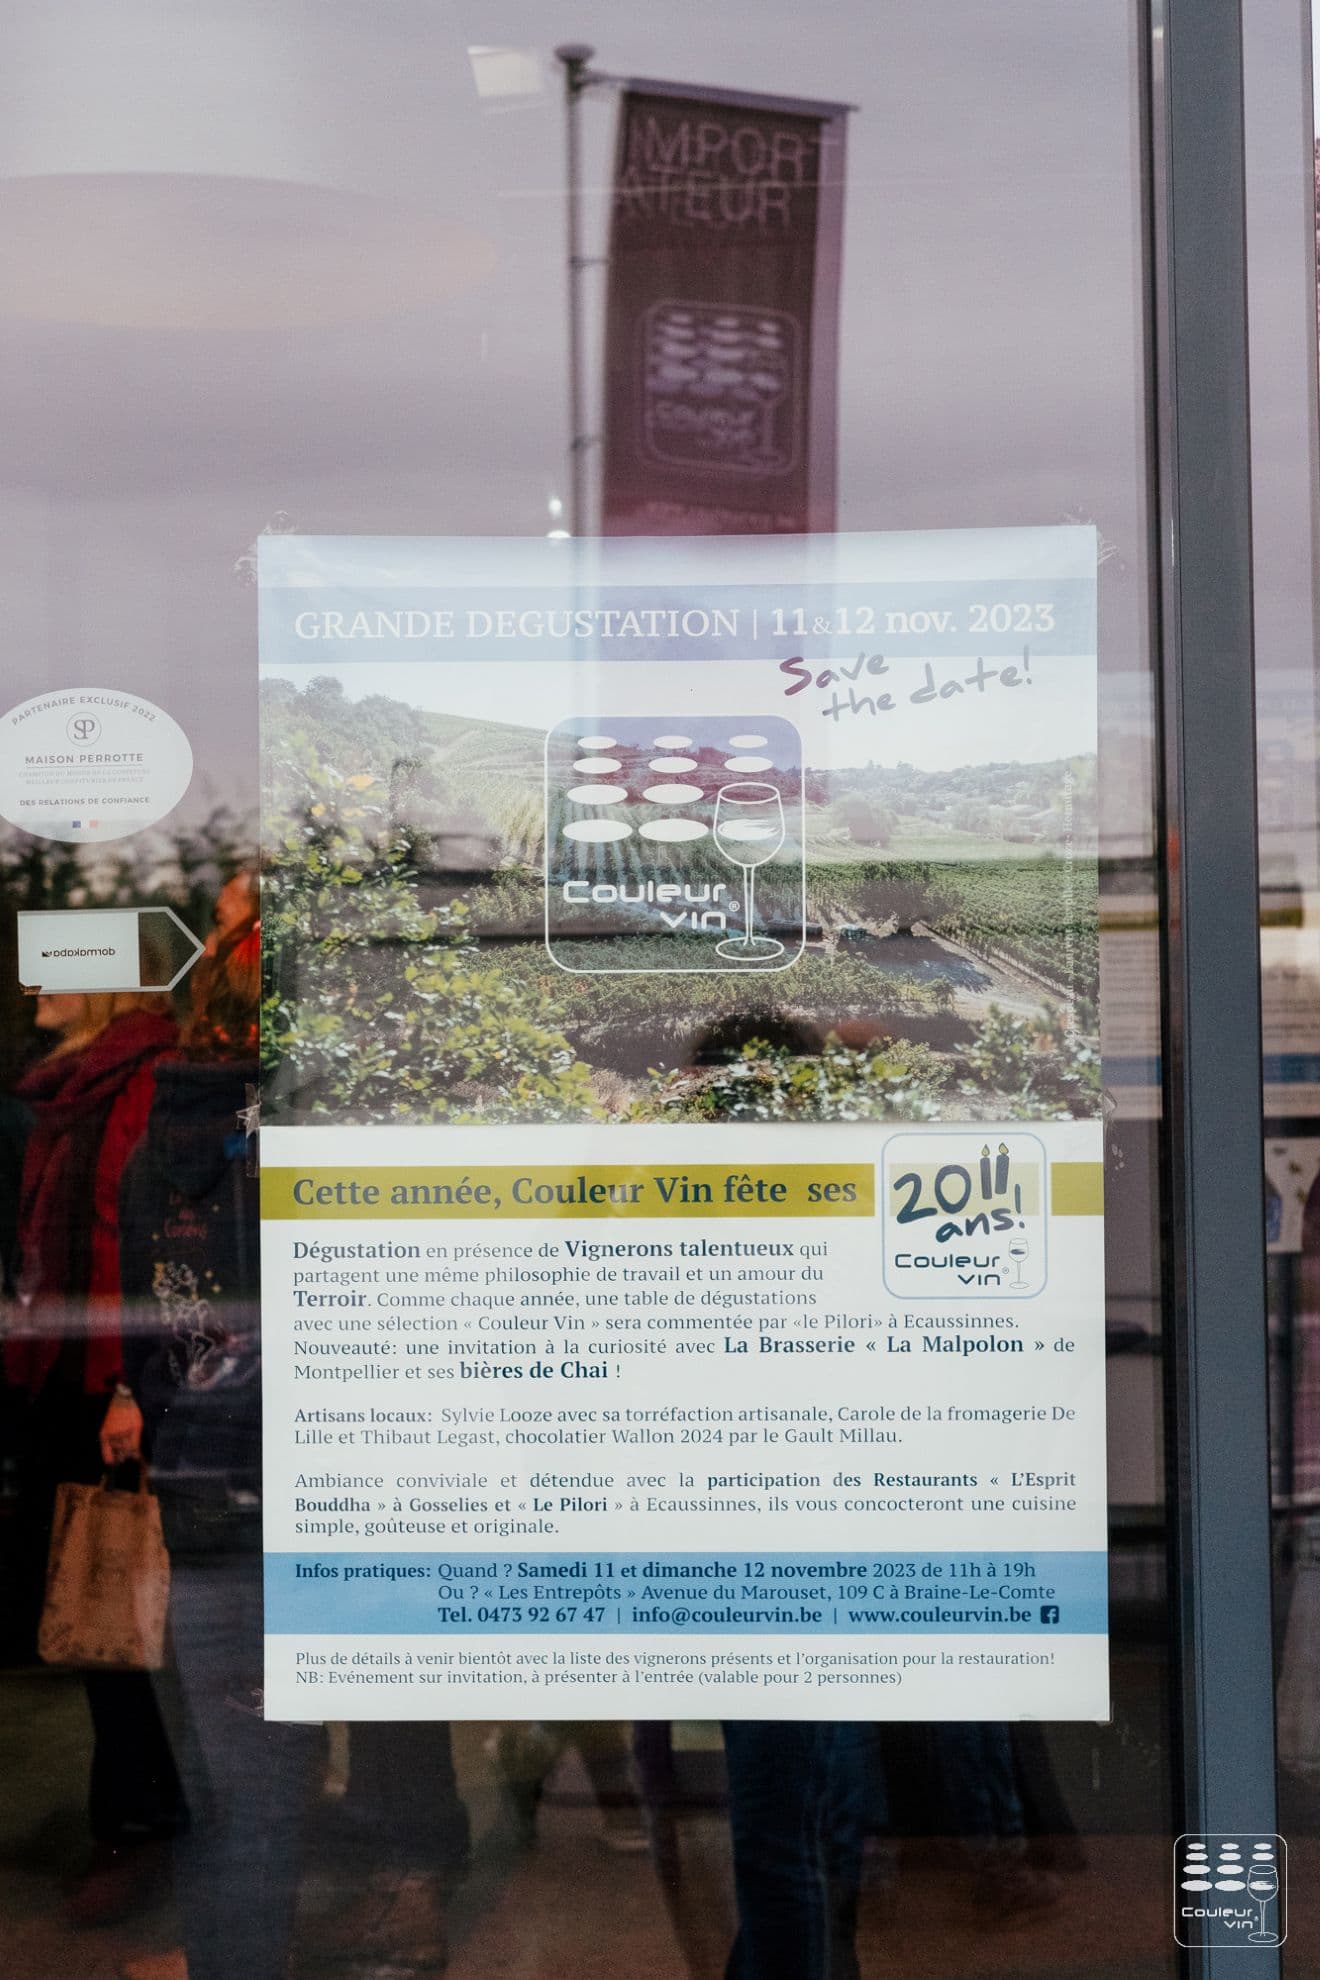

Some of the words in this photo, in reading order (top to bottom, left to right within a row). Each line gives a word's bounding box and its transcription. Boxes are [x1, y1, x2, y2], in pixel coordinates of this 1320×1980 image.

[295, 611, 454, 638] GRANDE
[466, 609, 741, 638] DEGUSTATION
[886, 609, 957, 633] nov.
[969, 603, 1056, 633] 2023
[779, 652, 890, 697] Save
[821, 687, 897, 722] the
[909, 645, 1033, 705] date!
[11, 695, 76, 726] PARTENAIRE
[80, 696, 129, 710] EXCLUSIF
[131, 705, 157, 722] 2022
[24, 754, 75, 765] MAISON
[79, 752, 145, 763] PERROTTE
[19, 798, 37, 807] DES
[38, 798, 86, 807] RELATIONS
[88, 797, 100, 806] DE
[101, 796, 150, 805] CONFIANCE
[563, 880, 726, 904] Couleur
[293, 1178, 380, 1206] Cette
[391, 1176, 501, 1210] année,
[512, 1176, 645, 1205] Couleur
[653, 1176, 713, 1203] Vin
[723, 1174, 787, 1202] fête
[808, 1183, 856, 1202] ses
[935, 1183, 1026, 1243] ans!
[293, 1241, 421, 1262] Dégustation
[426, 1248, 447, 1258] en
[454, 1243, 532, 1261] présence
[538, 1243, 559, 1257] de
[564, 1240, 673, 1261] Vignerons
[680, 1239, 794, 1256] talentueux
[800, 1242, 827, 1259] qui
[895, 1253, 1000, 1268] Couleur
[293, 1290, 371, 1307] Terroir.
[377, 1293, 445, 1307] Comme
[451, 1292, 515, 1310] chaque
[520, 1292, 579, 1309] année,
[586, 1295, 618, 1305] une
[624, 1291, 668, 1305] table
[674, 1291, 695, 1305] de
[701, 1290, 816, 1308] dégustations
[294, 1365, 399, 1382] Montpellier
[405, 1366, 421, 1379] et
[428, 1368, 454, 1379] ses
[460, 1361, 523, 1378] bières
[529, 1361, 553, 1378] de
[561, 1361, 608, 1378] Chai
[295, 1408, 365, 1423] Artisans
[370, 1408, 431, 1422] locaux:
[442, 1408, 494, 1425] Sylvie
[500, 1408, 552, 1422] Looze
[557, 1411, 597, 1422] avec
[603, 1411, 620, 1422] sa
[626, 1406, 733, 1422] torréfaction
[738, 1406, 832, 1423] artisanale,
[838, 1406, 895, 1421] Carole
[900, 1406, 921, 1421] de
[927, 1406, 942, 1421] la
[948, 1406, 1046, 1424] fromagerie
[1052, 1406, 1075, 1420] De
[295, 1429, 333, 1447] Lille
[339, 1432, 355, 1445] et
[361, 1429, 431, 1444] Thibaut
[437, 1430, 500, 1447] Legast,
[506, 1429, 606, 1446] chocolatier
[611, 1429, 674, 1443] Wallon
[681, 1429, 723, 1443] 2024
[728, 1432, 758, 1446] par
[764, 1428, 779, 1443] le
[785, 1428, 833, 1443] Gault
[840, 1428, 902, 1442] Millau.
[296, 1519, 359, 1536] simple,
[365, 1517, 445, 1536] goûteuse
[451, 1521, 468, 1533] et
[474, 1518, 559, 1536] originale.
[296, 1563, 339, 1578] Infos
[344, 1563, 430, 1581] pratiques:
[438, 1563, 498, 1581] Quand
[518, 1561, 587, 1577] Samedi
[594, 1562, 615, 1577] 11
[621, 1565, 637, 1577] et
[642, 1560, 737, 1578] dimanche
[744, 1562, 765, 1577] 12
[771, 1561, 867, 1577] novembre
[873, 1561, 916, 1577] 2023
[921, 1562, 942, 1577] de
[950, 1562, 981, 1577] 11h
[986, 1561, 998, 1578] à
[1004, 1562, 1036, 1577] 19h
[438, 1585, 464, 1599] Ou
[498, 1586, 528, 1599] Les
[533, 1583, 621, 1603] Entrepôts
[641, 1585, 707, 1600] Avenue
[712, 1585, 736, 1600] du
[740, 1582, 831, 1602] Marouset,
[838, 1585, 868, 1599] 109
[872, 1584, 885, 1600] C
[888, 1584, 900, 1600] à
[904, 1585, 1055, 1599] Braine-Le-Comte
[438, 1606, 472, 1622] Tel.
[478, 1607, 522, 1622] 0473
[528, 1607, 549, 1622] 92
[556, 1607, 577, 1622] 67
[583, 1607, 605, 1622] 47
[632, 1606, 822, 1626] info@couleurvin.be
[848, 1606, 1031, 1622] www.couleurvin.be
[296, 1652, 326, 1664] Plus
[330, 1652, 348, 1665] de
[352, 1652, 402, 1665] détails
[404, 1651, 413, 1665] à
[416, 1652, 454, 1664] venir
[459, 1651, 512, 1664] bientôt
[516, 1655, 548, 1664] avec
[553, 1652, 566, 1665] la
[570, 1652, 602, 1665] liste
[606, 1652, 630, 1664] des
[634, 1652, 706, 1667] vignerons
[711, 1652, 773, 1667] présents
[777, 1654, 791, 1664] et
[796, 1652, 898, 1667] l'organisation
[903, 1656, 936, 1667] pour
[941, 1652, 954, 1664] la
[959, 1652, 1054, 1664] restauration!
[296, 1671, 323, 1683] NB:
[328, 1671, 414, 1687] Evénement
[419, 1674, 443, 1683] sur
[448, 1670, 527, 1685] invitation,
[531, 1669, 541, 1684] à
[544, 1670, 618, 1687] présenter
[621, 1669, 631, 1684] à
[635, 1670, 694, 1684] l'entrée
[697, 1670, 758, 1686] (valable
[764, 1672, 800, 1686] pour
[803, 1670, 813, 1684] 2
[816, 1667, 904, 1686] personnes)
